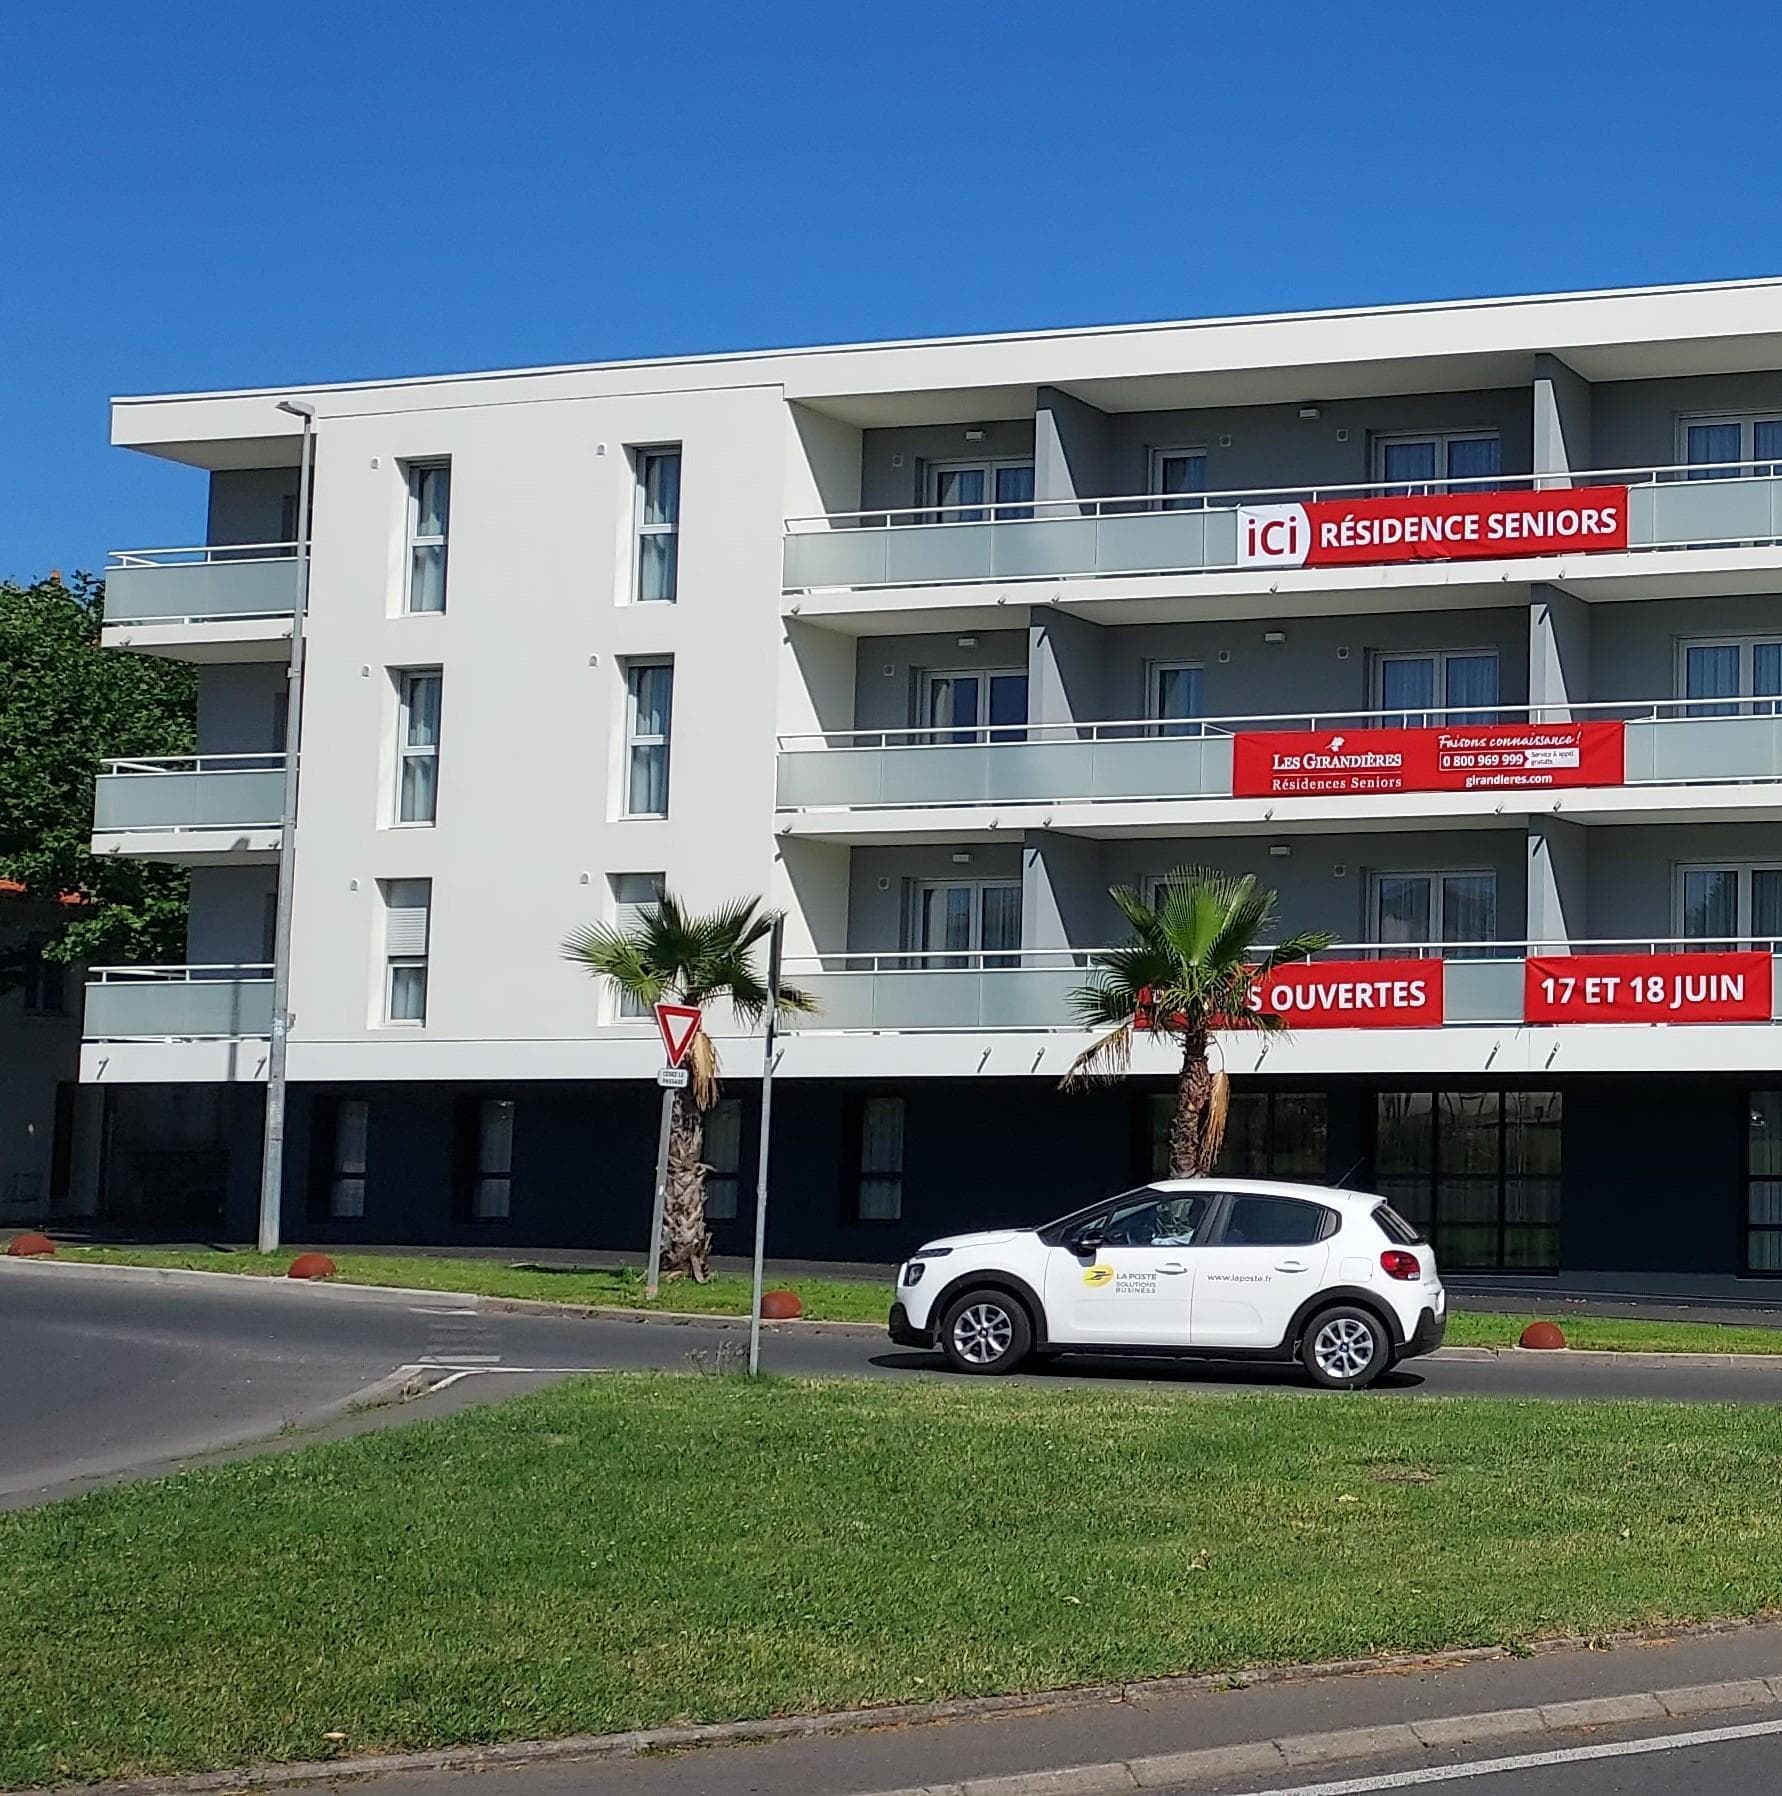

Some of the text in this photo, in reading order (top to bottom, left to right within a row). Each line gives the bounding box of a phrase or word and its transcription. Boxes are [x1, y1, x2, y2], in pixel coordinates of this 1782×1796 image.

[1320, 507, 1617, 548] RÉSIDENCE SENIORS
[1438, 733, 1486, 749] Faisons
[1489, 731, 1575, 747] connaissance
[1442, 753, 1524, 767] 0 800 969 999
[1272, 776, 1402, 790] Résidences Seniors
[1465, 774, 1553, 788] girandieres.com
[1270, 980, 1426, 1012] OUVERTES
[1541, 974, 1744, 1010] 17 ET 18 JUIN
